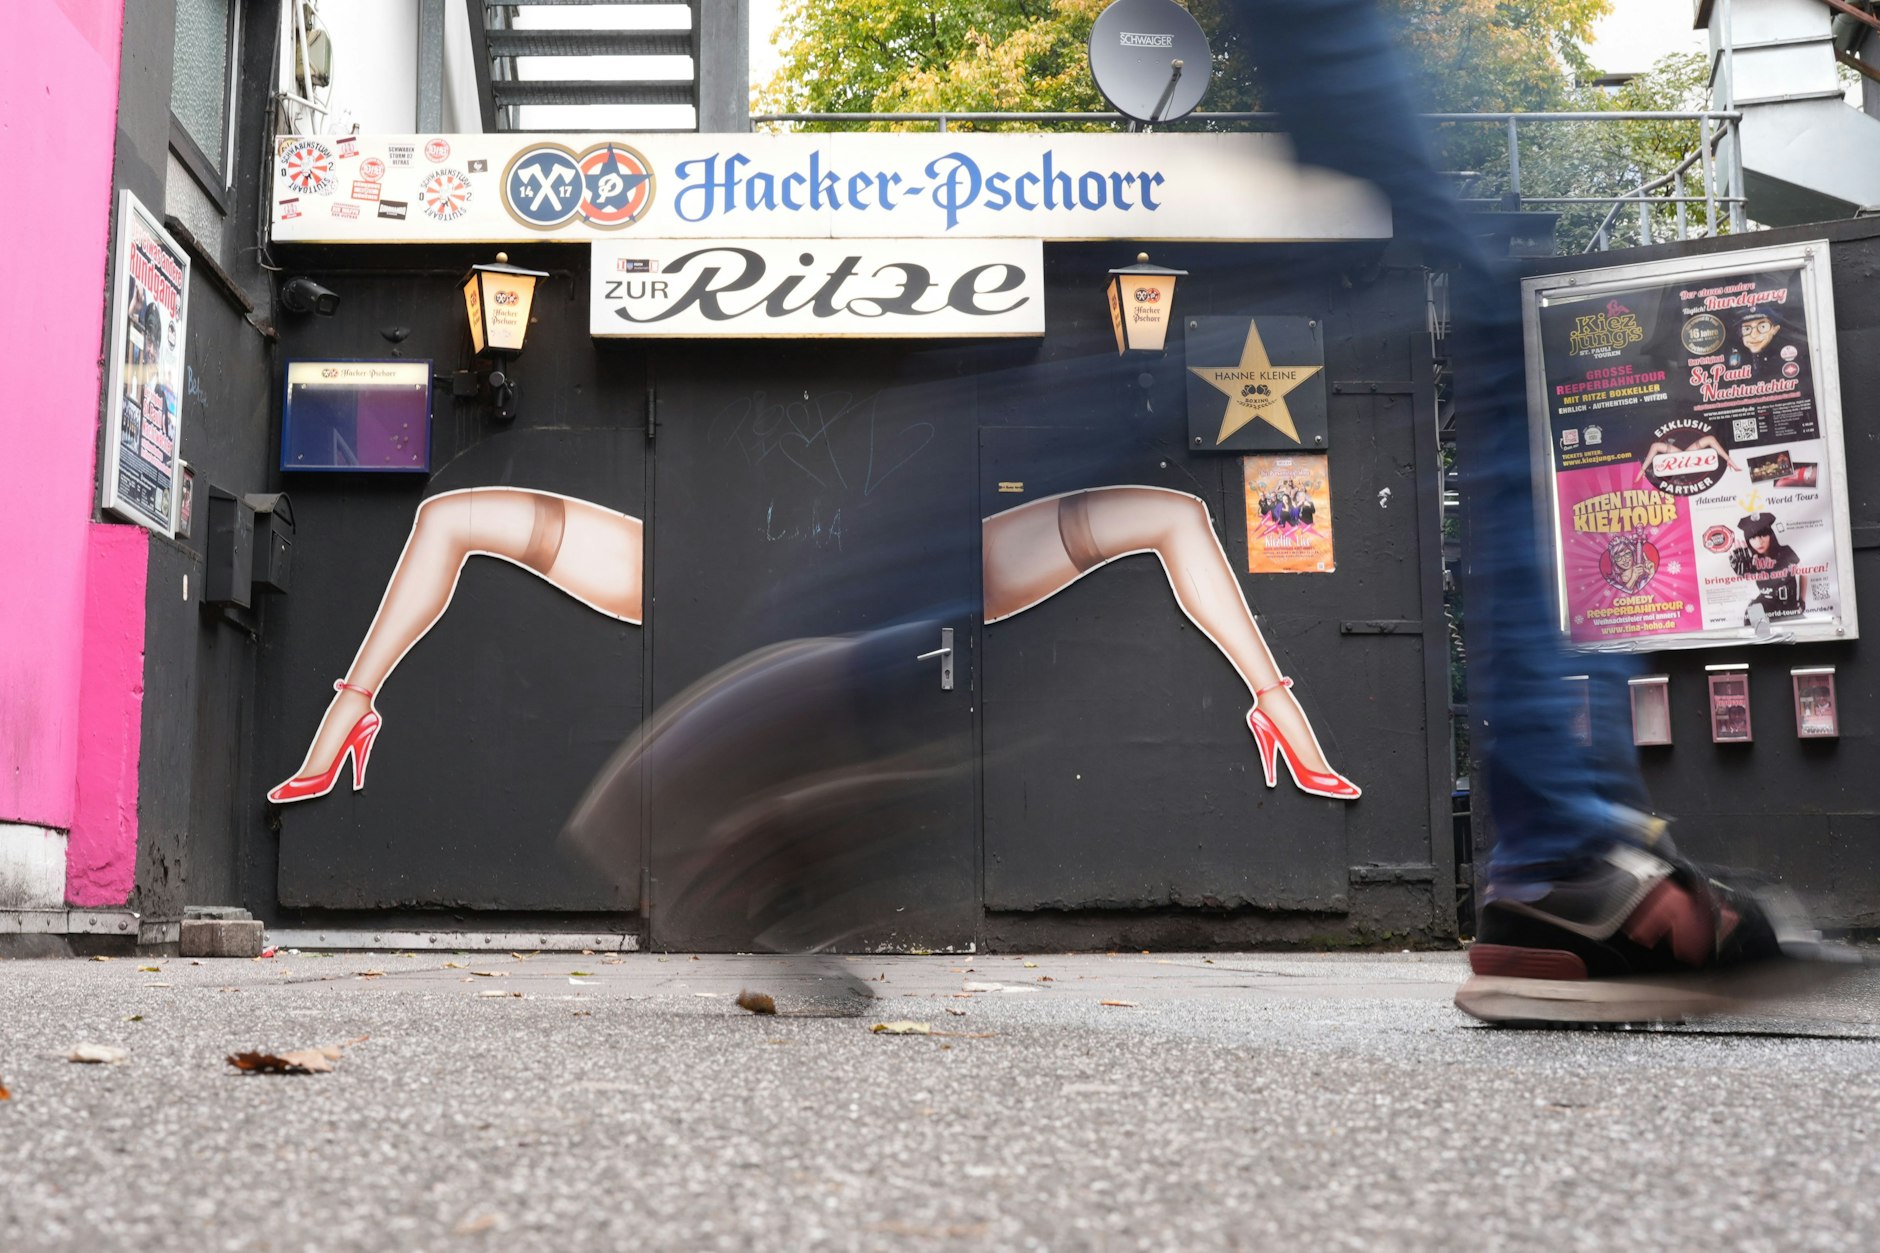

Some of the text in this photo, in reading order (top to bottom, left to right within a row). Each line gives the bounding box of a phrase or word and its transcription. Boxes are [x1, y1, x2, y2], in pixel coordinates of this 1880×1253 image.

[1120, 33, 1173, 46] SCHWAIGER
[519, 185, 572, 198] 14 17
[674, 149, 1165, 231] Hacker-Pschorr
[161, 250, 183, 290] andere
[129, 242, 177, 319] Rundgang
[605, 246, 1030, 323] ZUR Ritze
[1680, 290, 1697, 300] Der
[1724, 282, 1756, 294] andere
[1704, 288, 1788, 312] Rundgang
[1134, 306, 1160, 314] Hacker
[1576, 312, 1637, 336] Kiez
[1570, 326, 1643, 356] jungs
[1591, 346, 1611, 354] PAULI
[1594, 350, 1621, 359] TOUREN
[1215, 371, 1296, 381] HANNE KLEINE
[1586, 365, 1633, 380] GROSSE
[1556, 371, 1666, 395] REEPERBAHNTOUR
[1700, 379, 1798, 402] Nachtwächter
[1558, 392, 1668, 414] EHRLICH AUTHENTISCH WITZIG
[1564, 384, 1660, 405] MIT RITZE BOXKELLER
[1654, 419, 1712, 438] EXKLUSIV
[1563, 452, 1632, 467] www.kiezjungs.com
[1660, 477, 1714, 494] PARTNER
[1573, 489, 1675, 516] TITTEN TINA'S
[1695, 492, 1819, 506] Adventure World Tours
[1573, 504, 1678, 533] KIEZTOUR
[1752, 556, 1777, 570] Wir
[1705, 562, 1829, 585] bringen Euch auf Touren!
[1613, 595, 1655, 606] COMEDY
[1593, 615, 1643, 626] Weihnachtsfeier
[1601, 620, 1676, 635] www.tina-hoho.de
